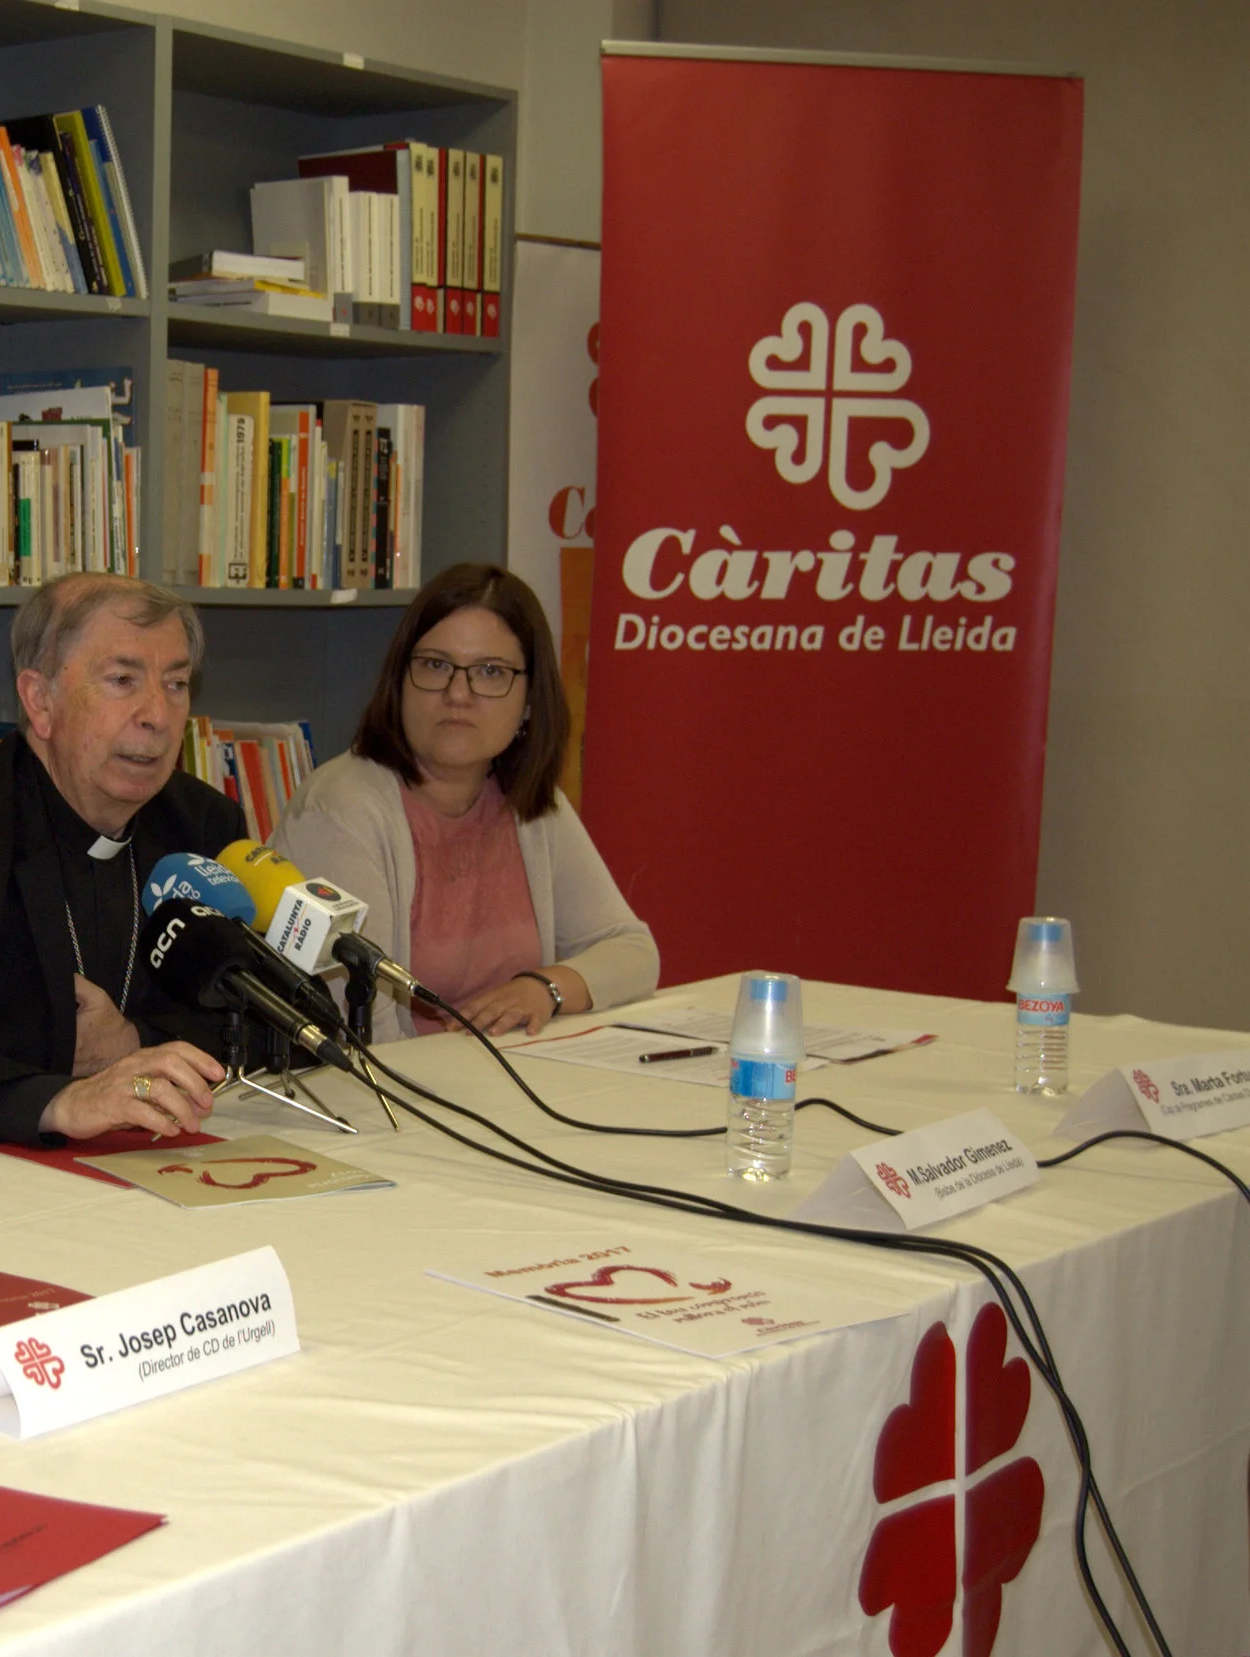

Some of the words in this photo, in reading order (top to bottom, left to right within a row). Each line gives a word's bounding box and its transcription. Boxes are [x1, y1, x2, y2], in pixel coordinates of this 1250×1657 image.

[622, 524, 1016, 601] Càritas
[614, 613, 825, 651] Diocesana
[838, 615, 885, 651] de
[898, 615, 1018, 652] Lleida
[150, 917, 186, 969] acn
[1018, 999, 1065, 1012] BEZOYA
[1193, 1076, 1224, 1093] Marta
[906, 1155, 966, 1187] M.Salvador
[963, 1139, 1013, 1165] Gimenez
[80, 1342, 113, 1369] Sr.
[118, 1323, 177, 1358] Josep
[179, 1292, 273, 1336] Casanova
[138, 1353, 185, 1382] (Director
[187, 1342, 201, 1362] de
[202, 1338, 221, 1357] CD
[222, 1329, 236, 1348] de
